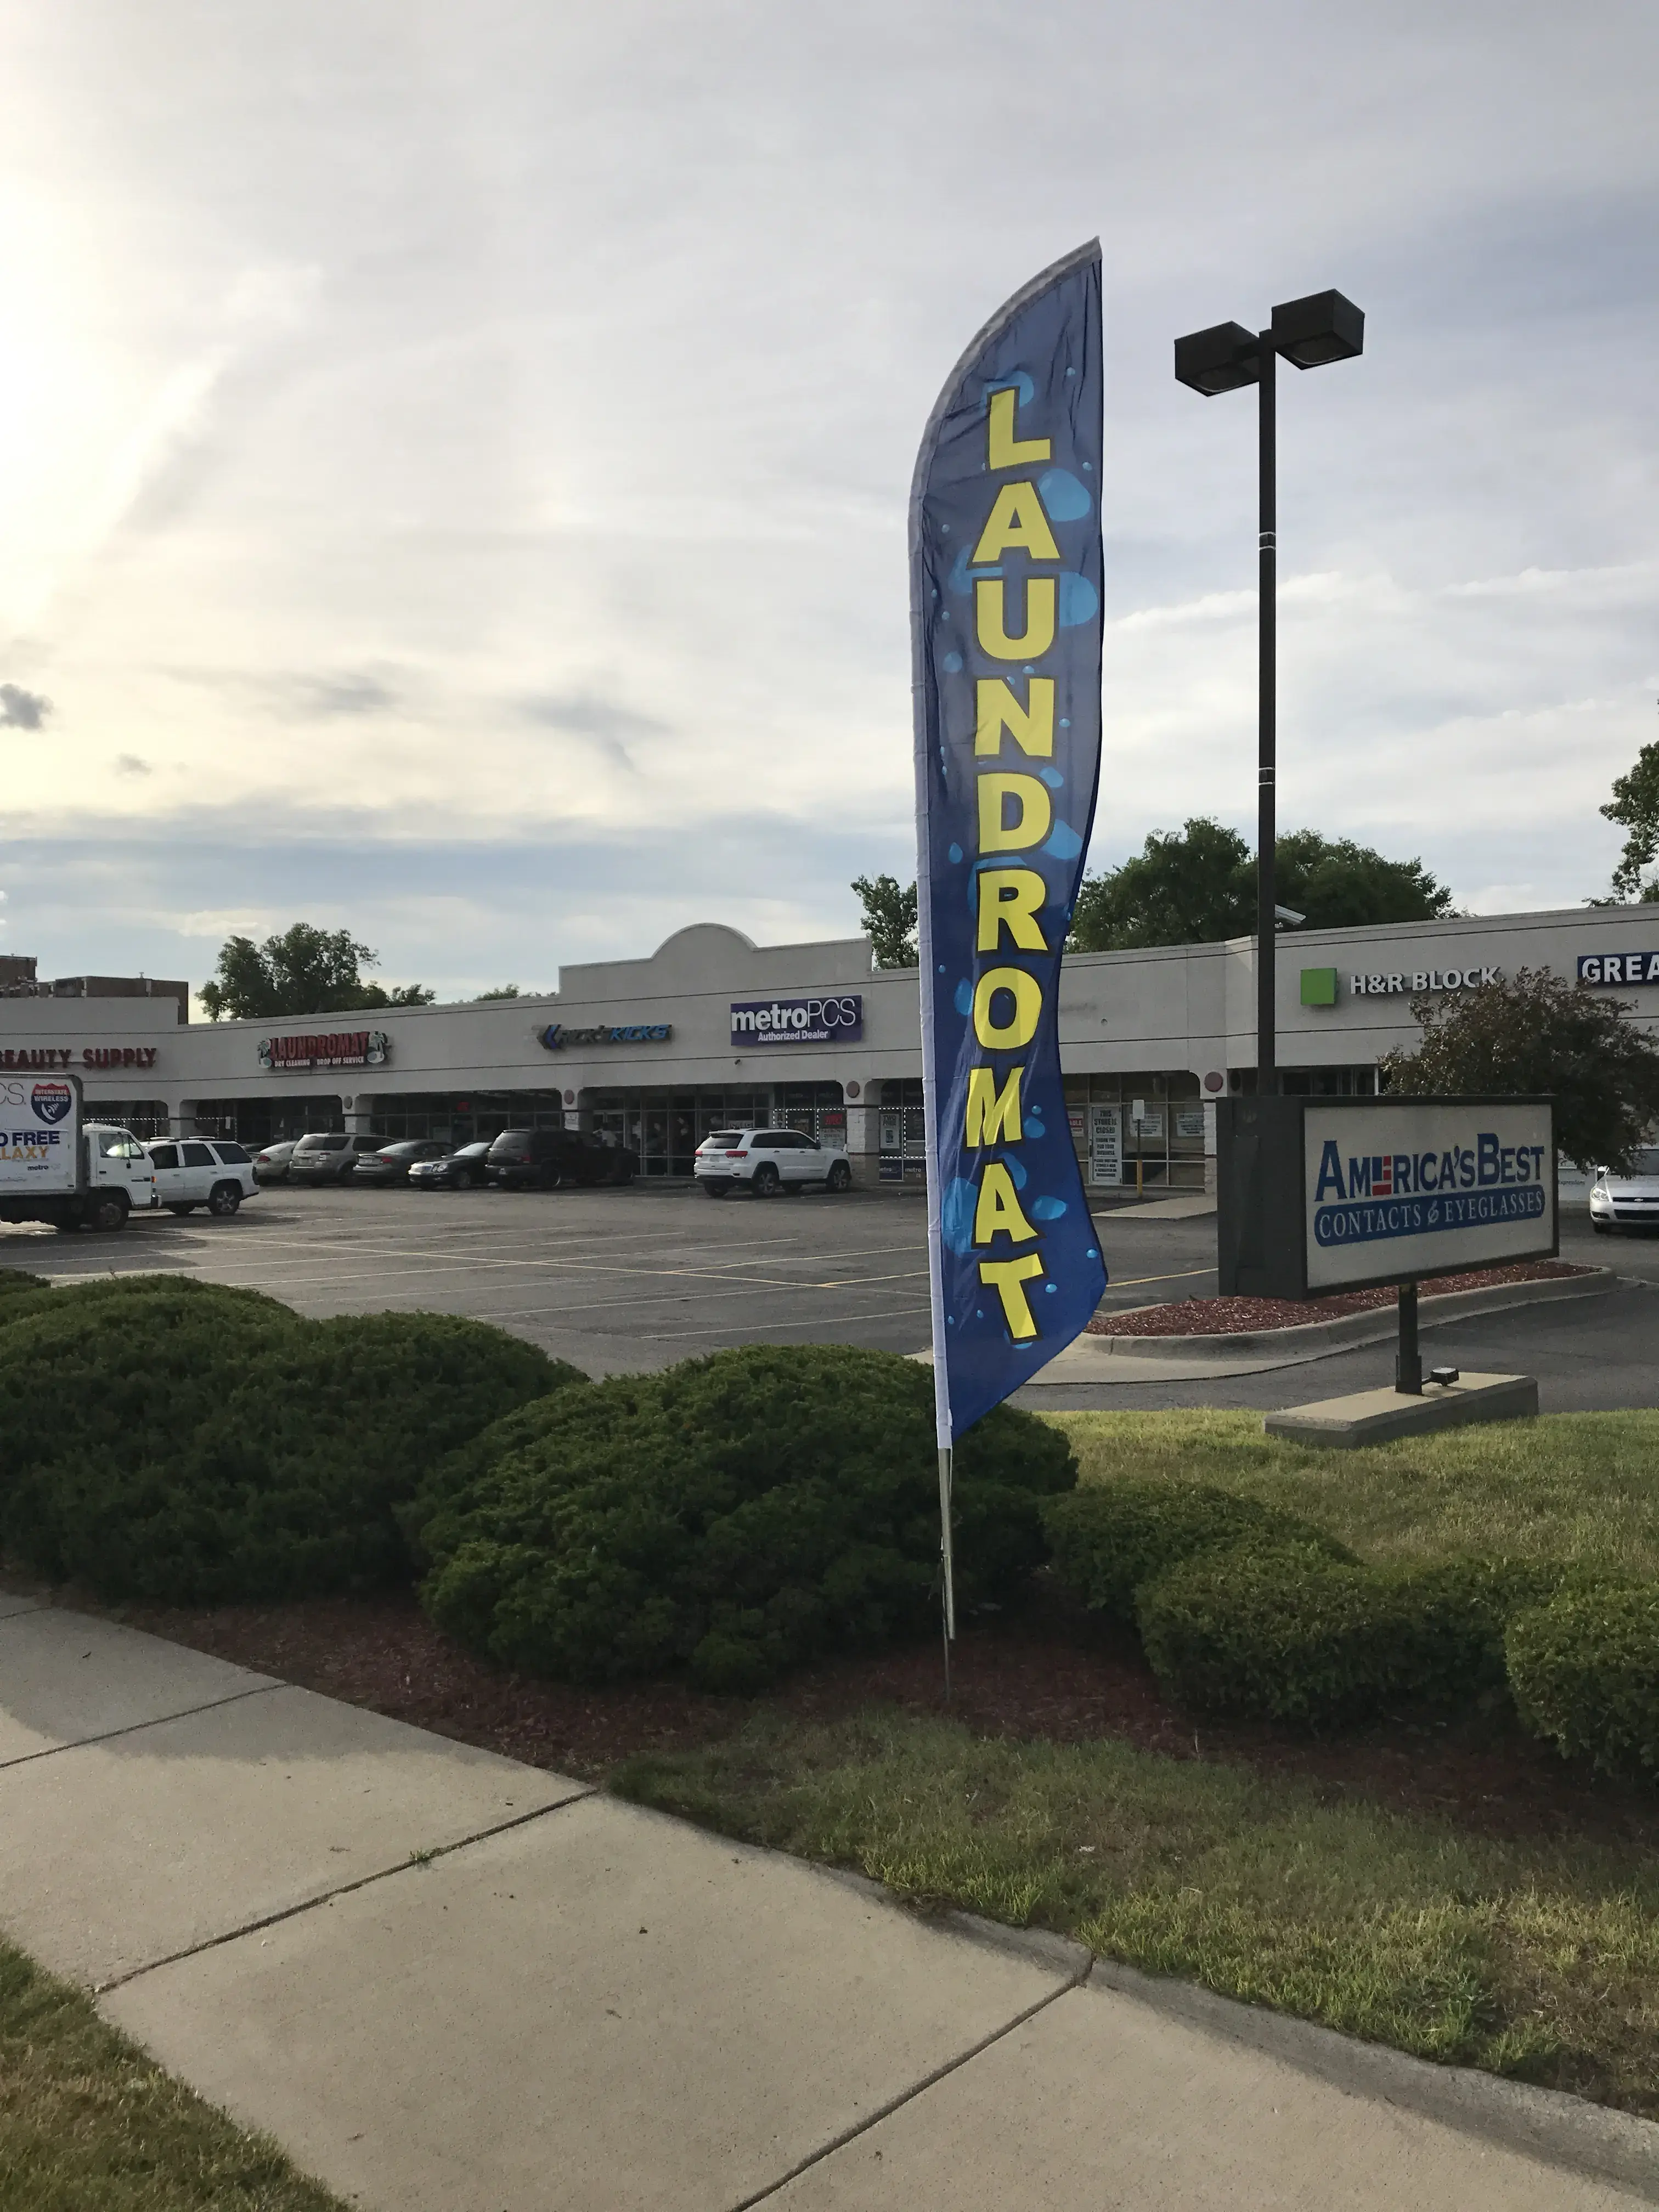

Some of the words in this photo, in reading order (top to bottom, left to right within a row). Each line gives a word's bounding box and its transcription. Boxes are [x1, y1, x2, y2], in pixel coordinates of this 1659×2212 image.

[967, 387, 1063, 1341] LAUNDROMAT
[1350, 973, 1403, 994] H&R
[1412, 967, 1500, 991] BLOCK
[731, 998, 855, 1031] metroPCS
[269, 1031, 370, 1059] LAUNDROMAT
[610, 1024, 670, 1041] KICKS
[758, 1031, 800, 1041] Authorized
[802, 1029, 828, 1039] Dealer
[82, 1048, 156, 1069] SUPPLY
[12, 1131, 60, 1146] FREE
[0, 1146, 48, 1160] LAXY
[1477, 1133, 1544, 1186] BEST
[1319, 1205, 1421, 1238] CONTACTS
[1428, 1200, 1439, 1224] &
[1445, 1191, 1542, 1222] EYEGLASSES
